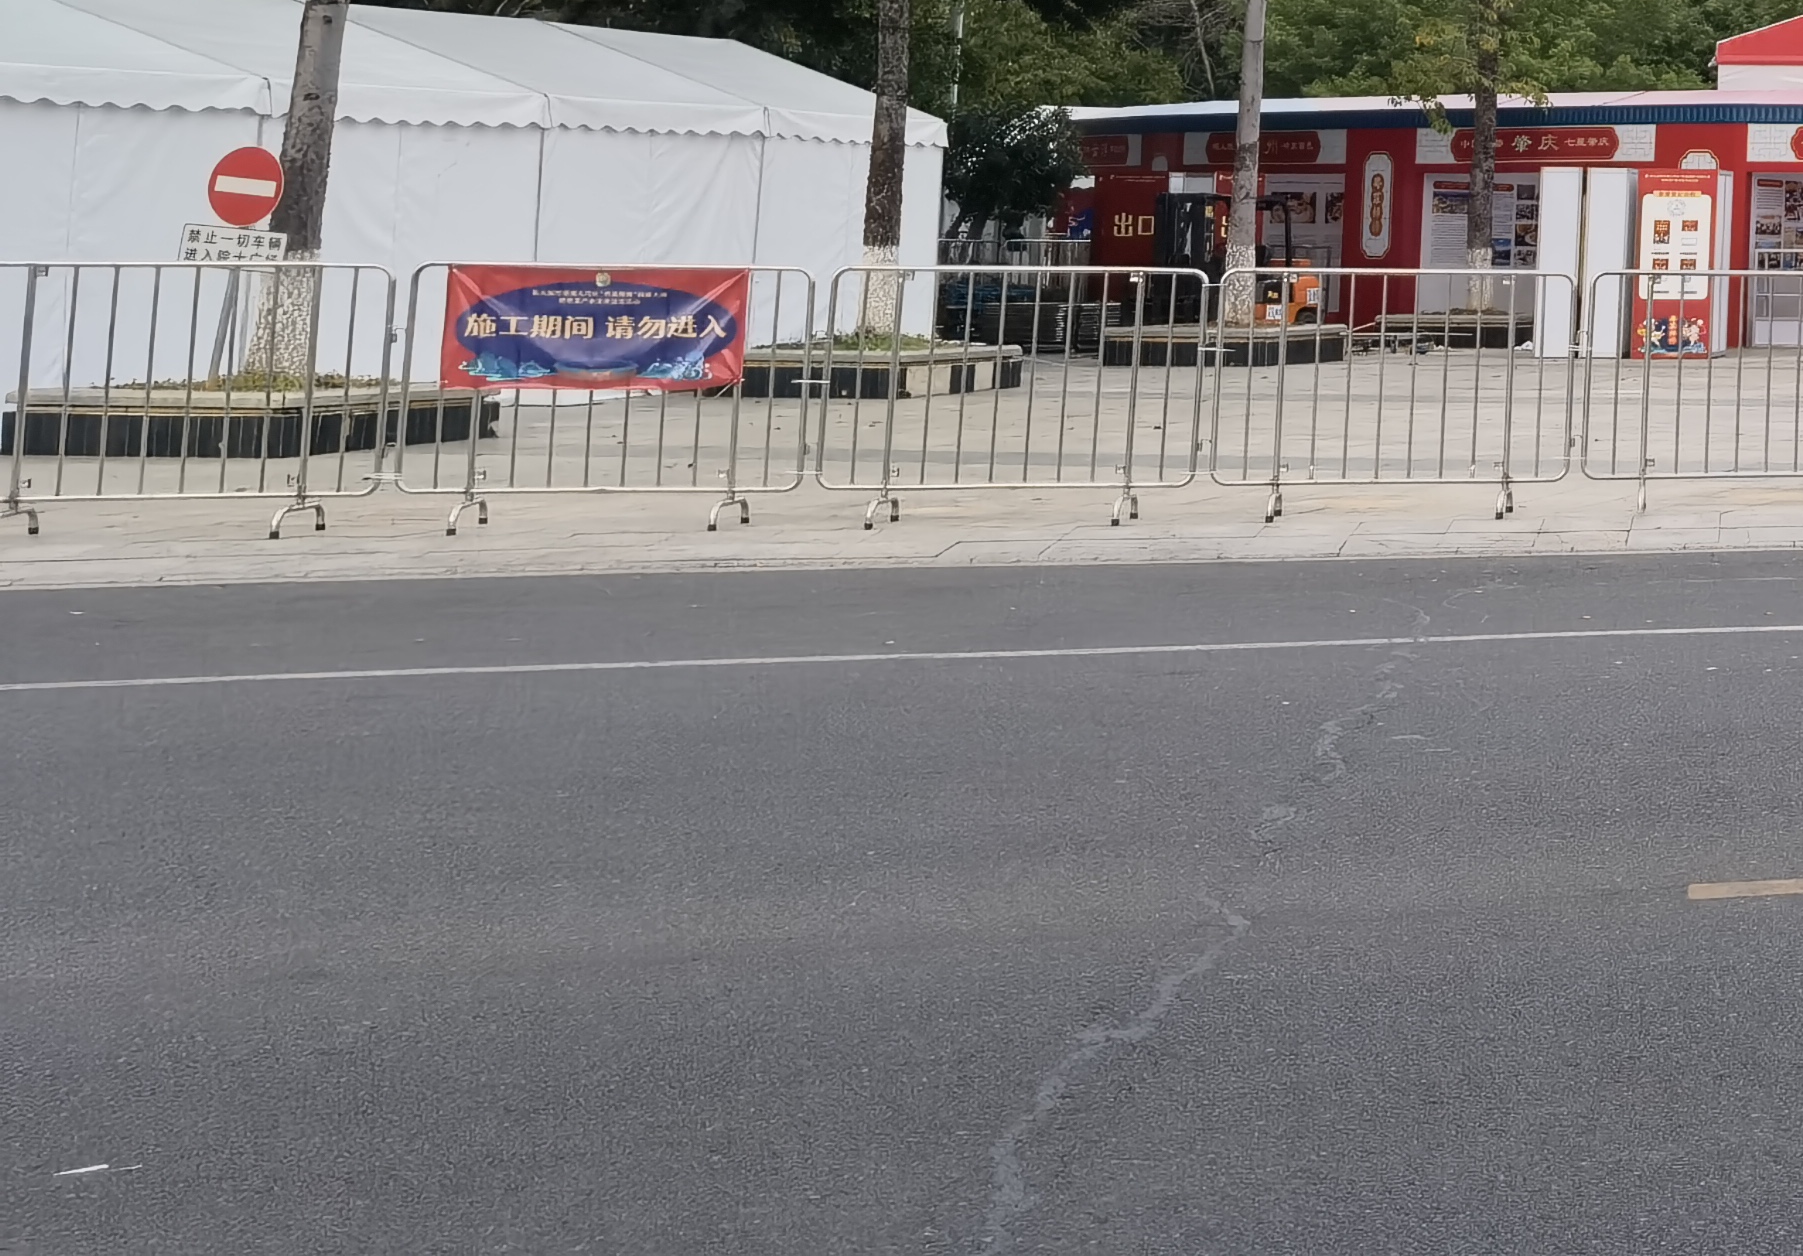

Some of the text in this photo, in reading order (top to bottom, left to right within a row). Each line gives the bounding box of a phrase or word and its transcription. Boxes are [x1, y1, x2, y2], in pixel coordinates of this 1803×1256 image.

[1511, 134, 1560, 153] 肇庆
[1113, 212, 1155, 237] 出口
[187, 229, 281, 251] 禁止一切车辆
[464, 313, 727, 339] 施工期间 请勿进入
